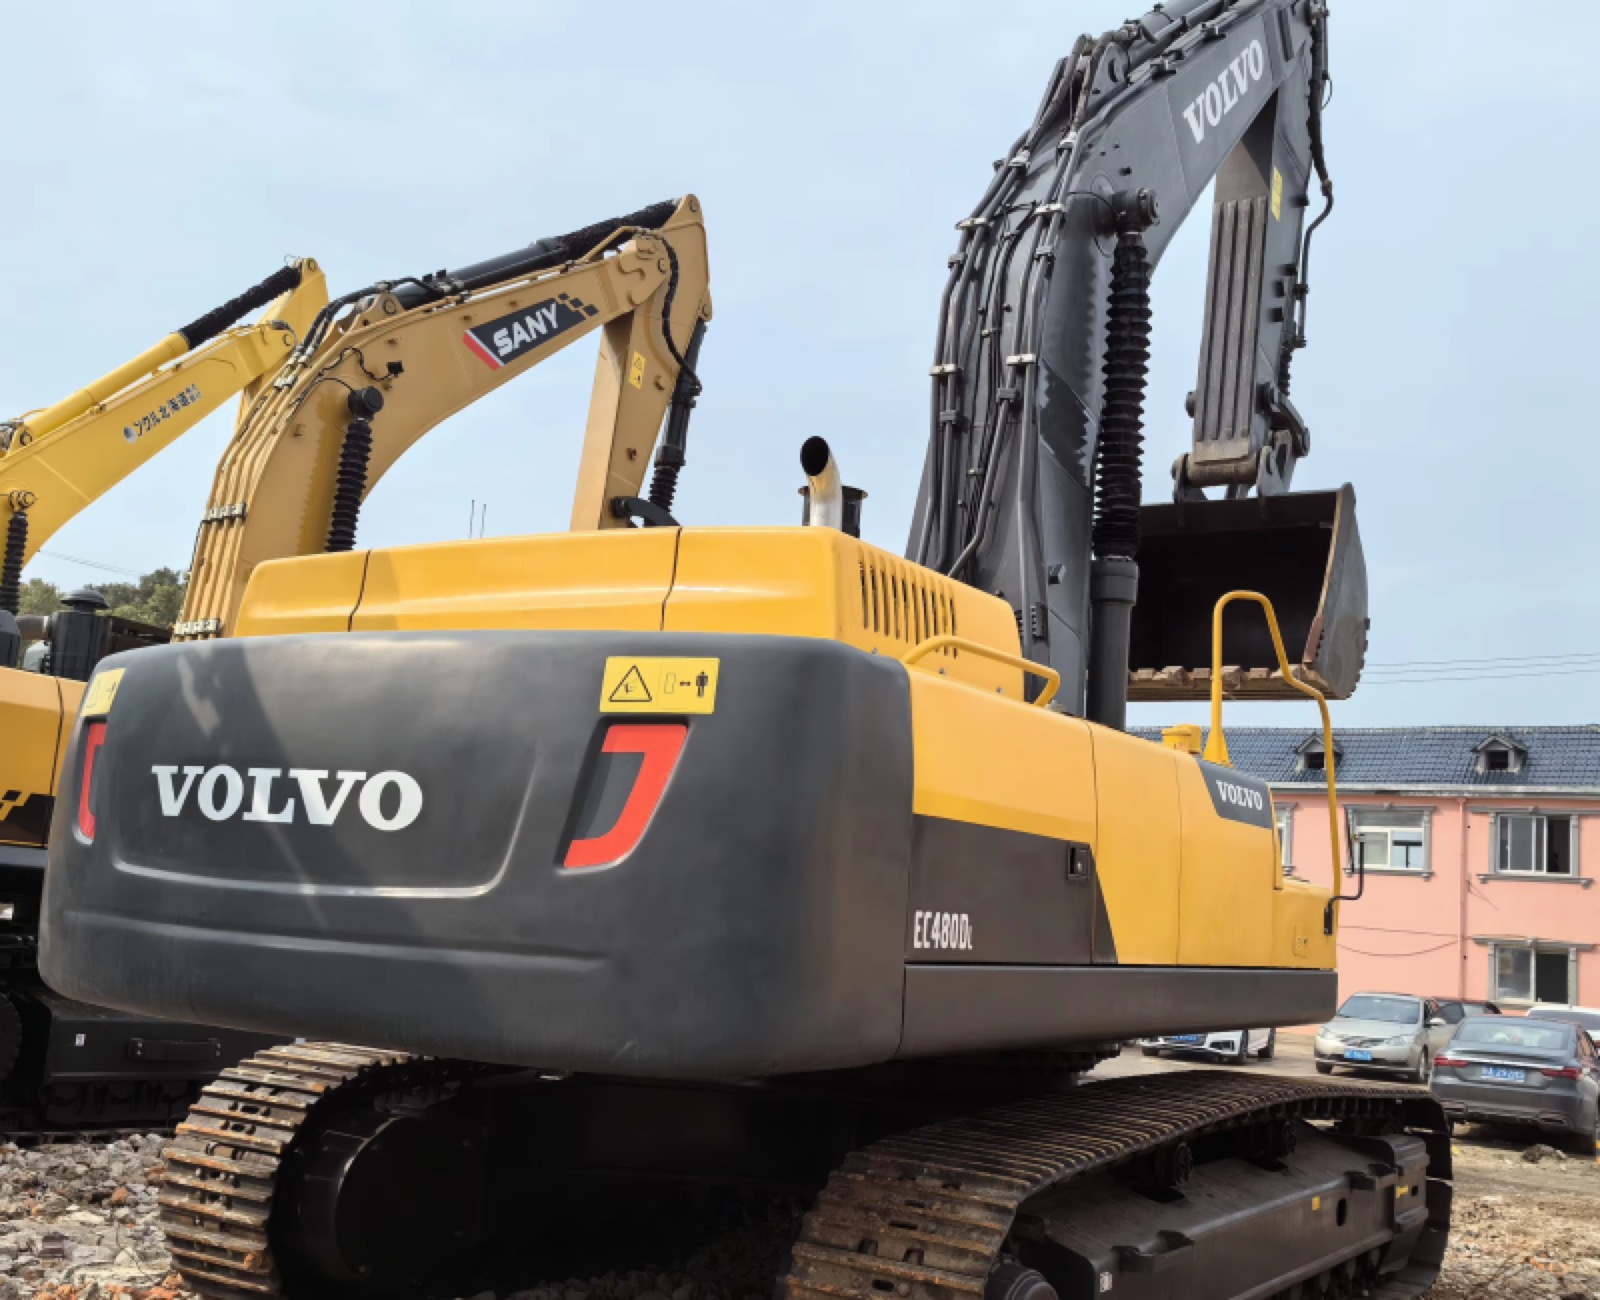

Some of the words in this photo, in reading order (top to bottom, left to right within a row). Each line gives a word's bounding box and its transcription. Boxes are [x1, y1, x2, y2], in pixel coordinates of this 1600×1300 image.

[1182, 39, 1264, 144] VOLVO
[493, 302, 558, 356] SANY
[151, 763, 423, 832] VOLVO
[1215, 779, 1263, 811] VOLVO
